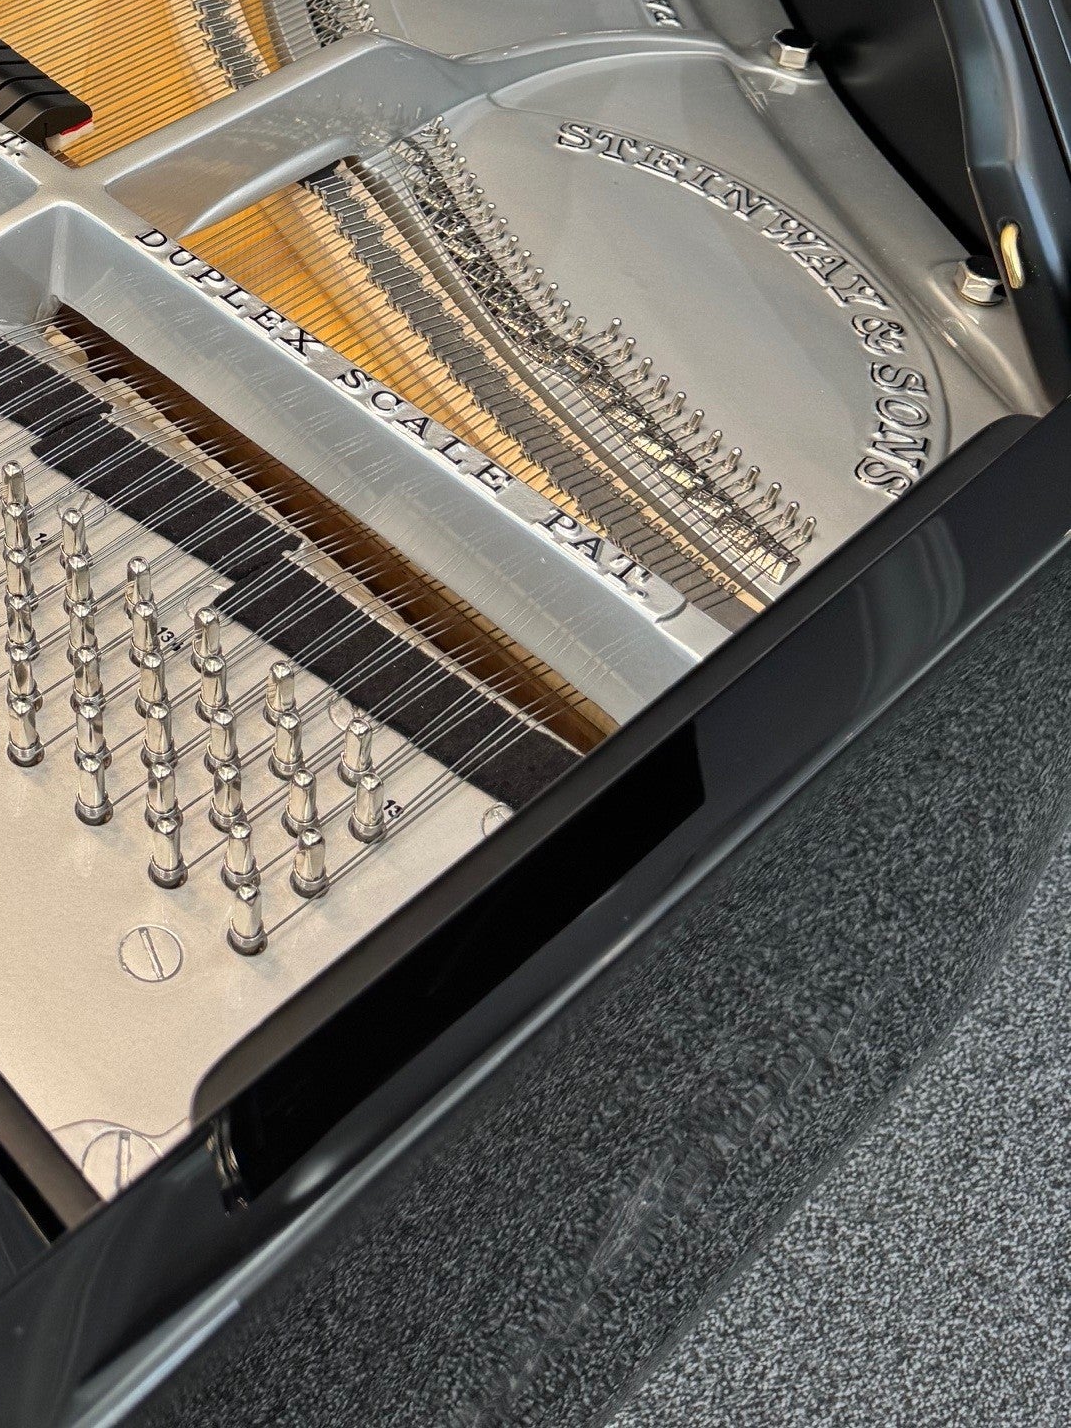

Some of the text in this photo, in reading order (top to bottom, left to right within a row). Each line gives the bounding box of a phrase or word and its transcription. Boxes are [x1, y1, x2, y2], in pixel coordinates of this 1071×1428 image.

[134, 228, 324, 358] DUPLEX
[334, 368, 513, 491] SCALE
[555, 120, 930, 499] STEINWAY & SONS
